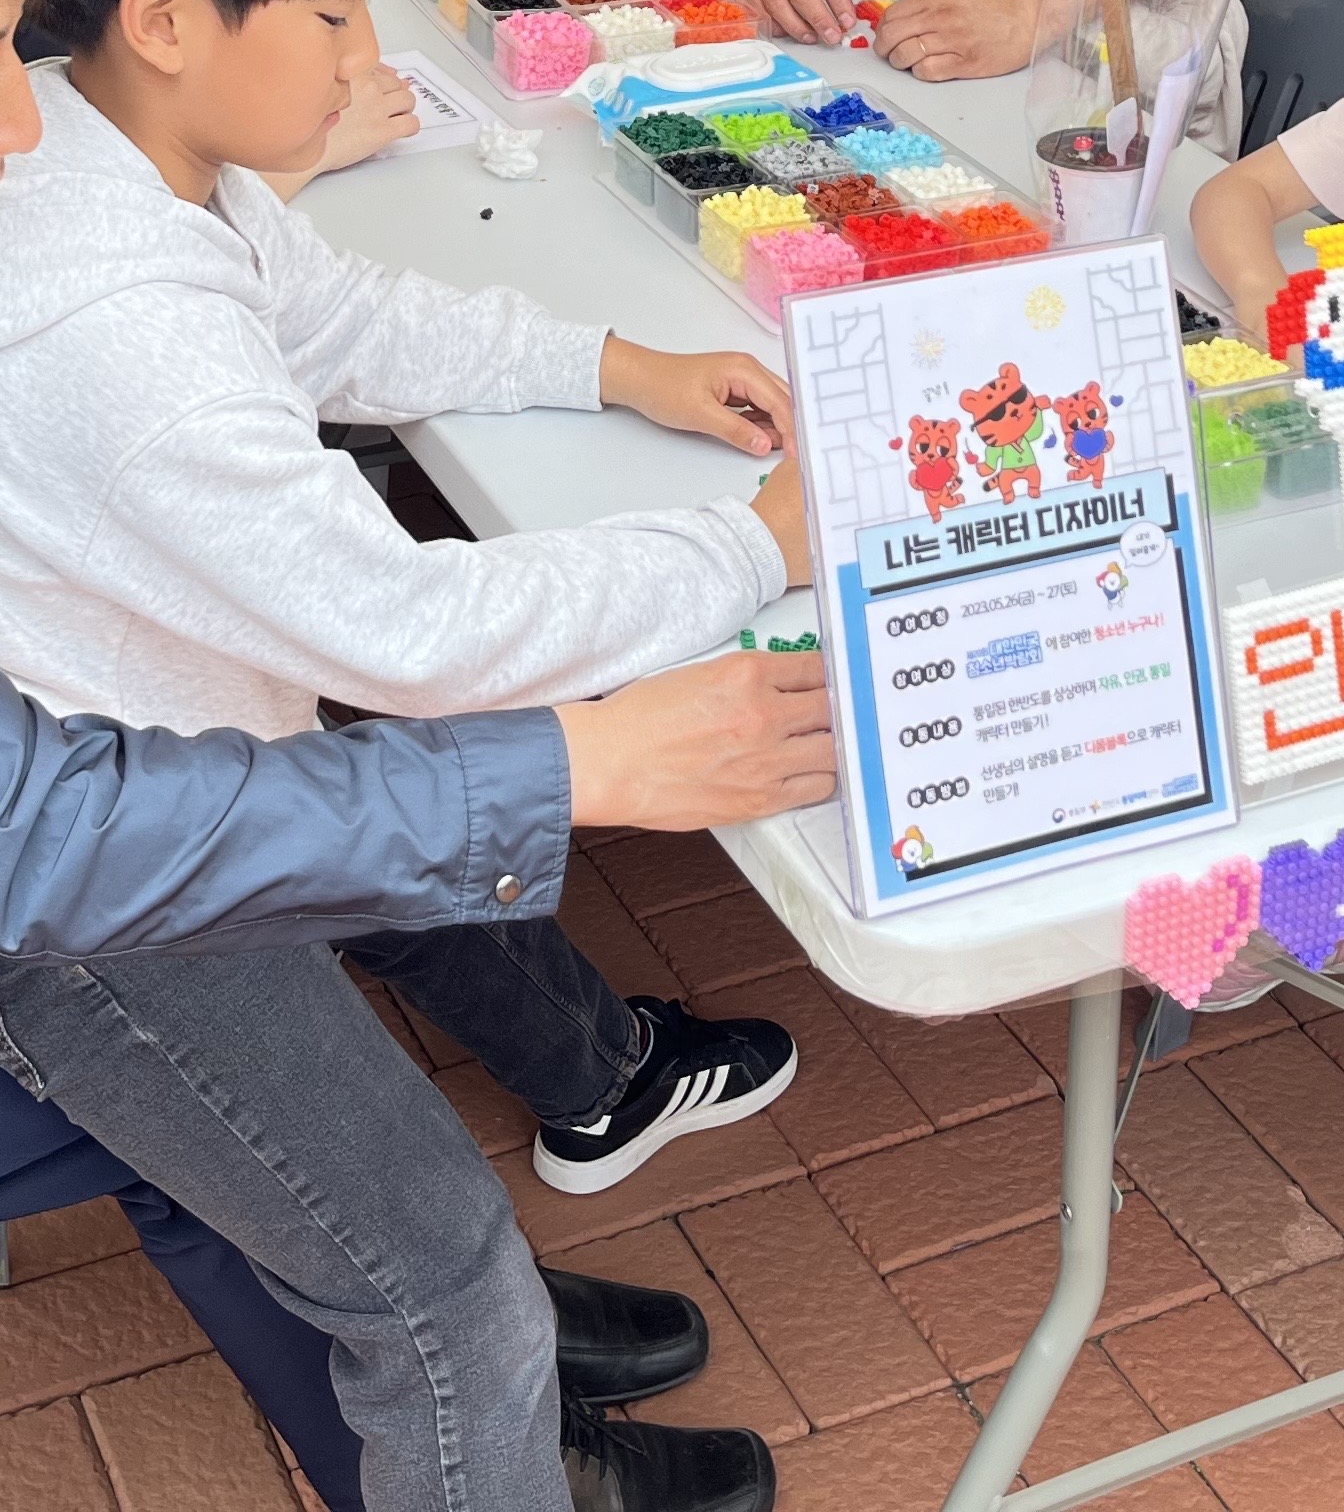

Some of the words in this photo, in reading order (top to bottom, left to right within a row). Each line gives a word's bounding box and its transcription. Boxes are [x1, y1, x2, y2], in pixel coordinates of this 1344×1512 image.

[884, 532, 941, 570] 나는
[946, 511, 1031, 556] 캐릭터
[1035, 488, 1145, 538] 디자이너
[888, 607, 948, 636] 참여일정
[960, 589, 1036, 618] 2023.05.26(금)
[1047, 580, 1078, 600] 27(토)
[894, 660, 954, 688] 참여대상
[1046, 637, 1058, 650] 에
[1060, 629, 1092, 648] 참여한
[1094, 622, 1126, 642] 청소년
[1127, 613, 1165, 634] 누구나!
[989, 631, 1040, 656] 대한민국
[901, 718, 961, 746] 활동내용
[973, 700, 1007, 722] 통일된
[1008, 689, 1052, 714] 한반도를
[1053, 677, 1097, 704] 상상하며
[1149, 662, 1172, 682] 통일
[975, 723, 1010, 744] 캐릭터
[1011, 714, 1050, 736] 만들기!
[909, 778, 968, 807] 활동방법
[981, 758, 1025, 781] 선생님의
[1027, 748, 1059, 771] 설명을
[1061, 744, 1083, 763] 듣고
[1149, 719, 1182, 741] 캐릭터
[983, 782, 1020, 804] 만들기!
